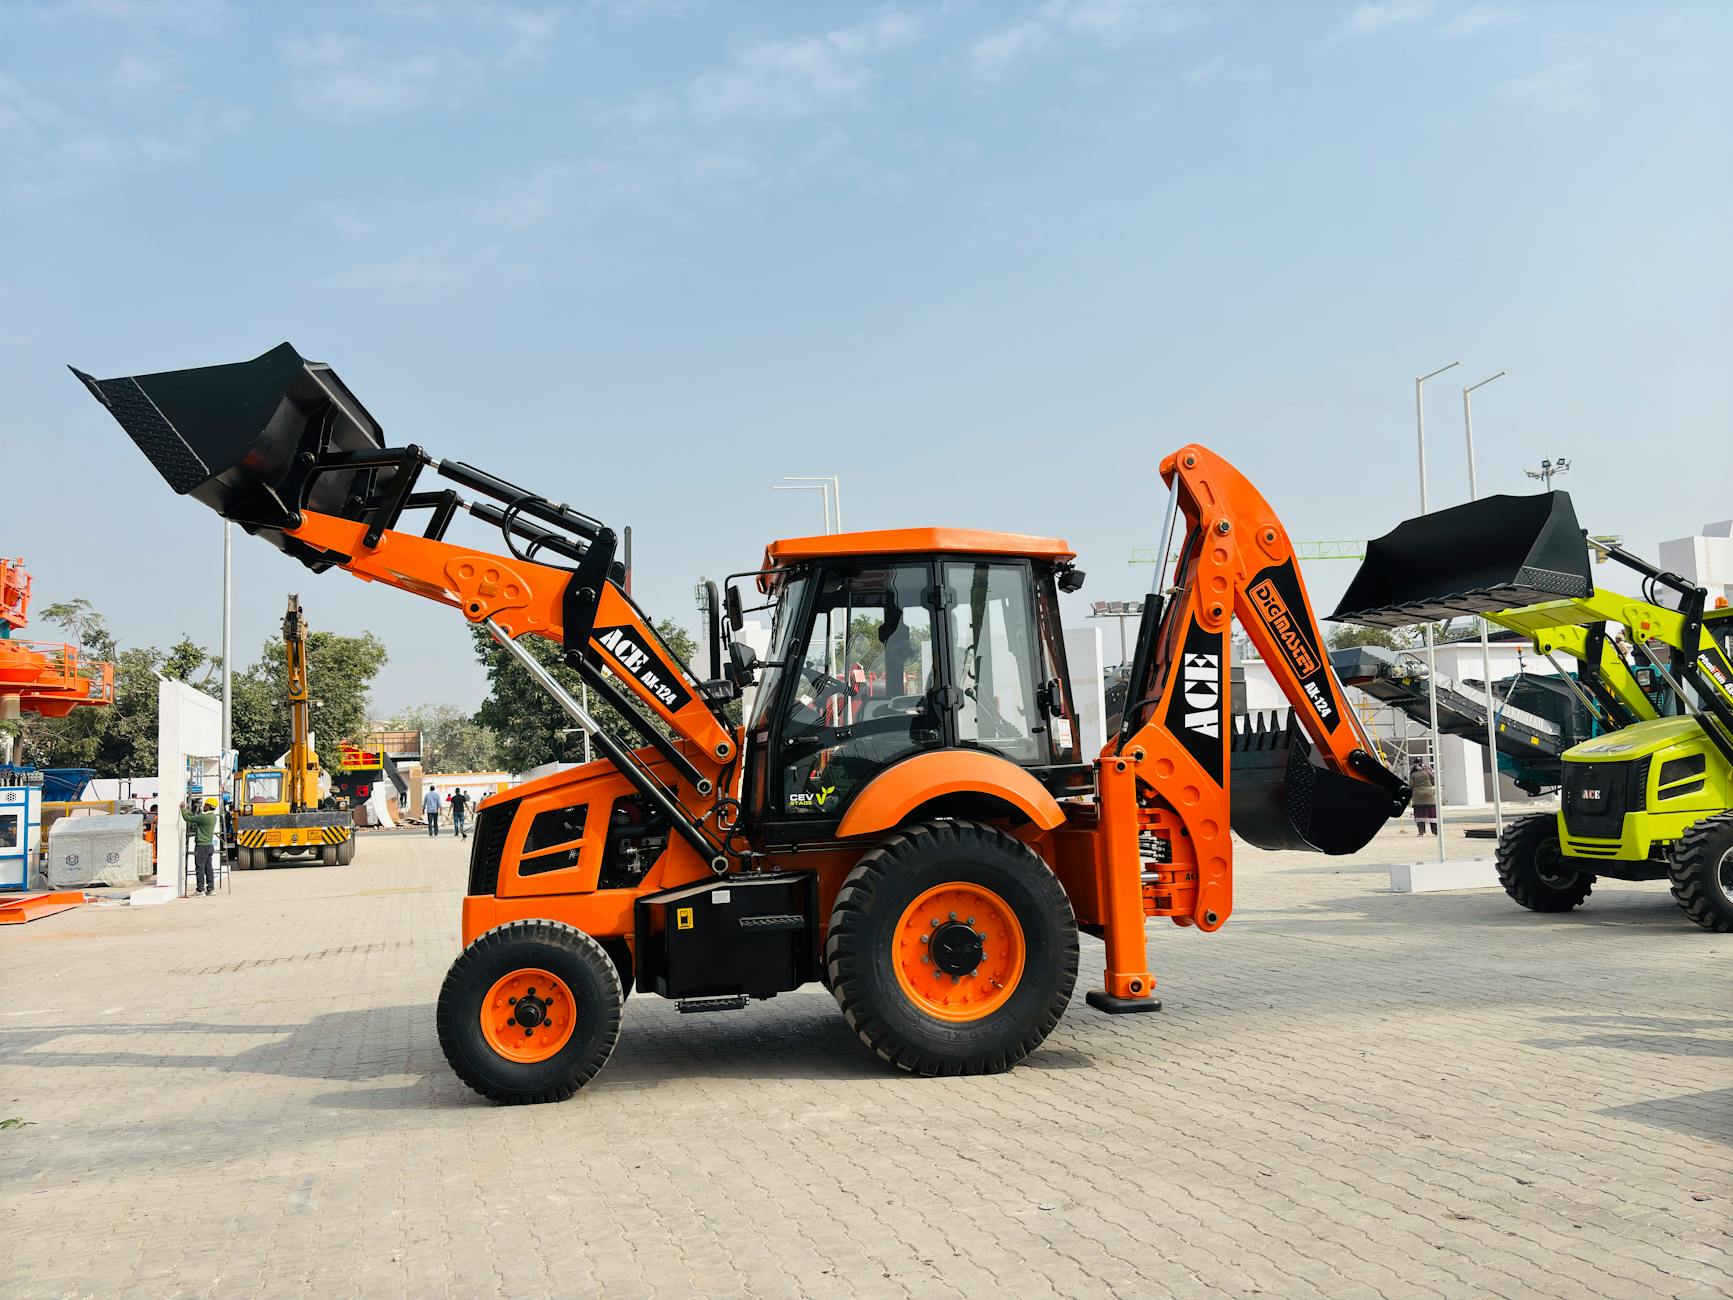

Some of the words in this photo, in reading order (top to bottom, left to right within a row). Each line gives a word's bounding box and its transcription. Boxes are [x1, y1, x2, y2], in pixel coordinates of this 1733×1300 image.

[599, 629, 649, 674] ACE
[640, 671, 677, 706] AX-124
[1184, 653, 1219, 739] ACE
[1304, 681, 1332, 718] AX-124
[789, 793, 814, 801] CEV
[1582, 789, 1601, 800] ACE
